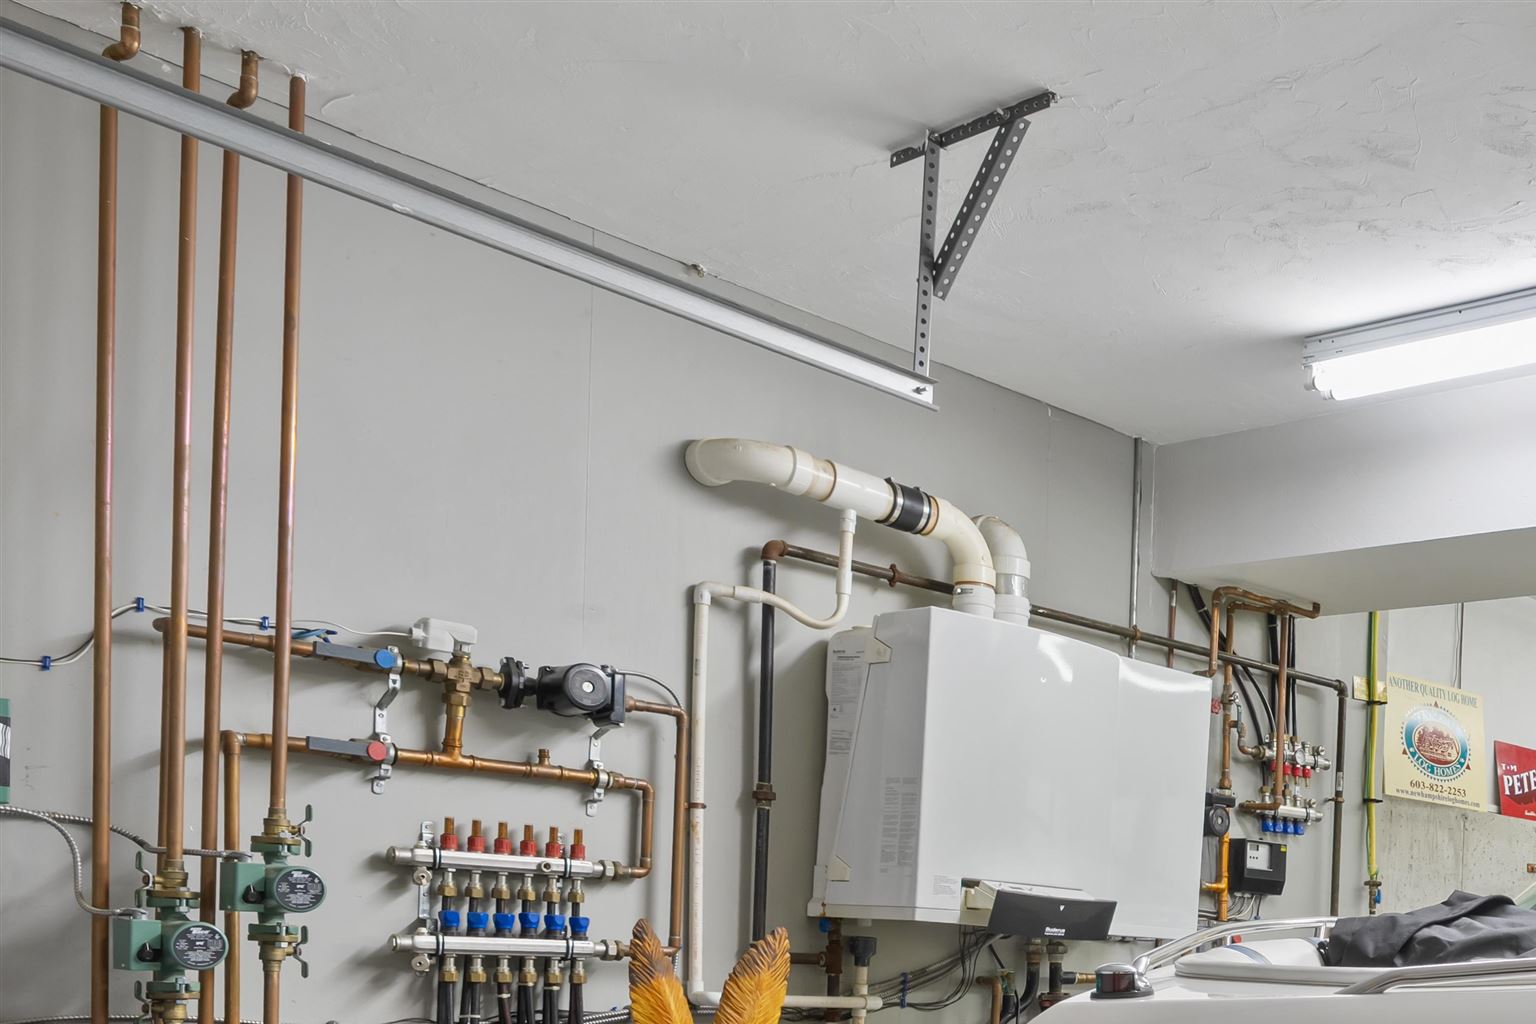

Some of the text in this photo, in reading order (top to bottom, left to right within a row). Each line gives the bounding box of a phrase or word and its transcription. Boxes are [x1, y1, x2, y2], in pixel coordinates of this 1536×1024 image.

[1389, 675, 1478, 706] ANOTHER QUALITY LOG HOME
[1413, 754, 1462, 777] LOG HOMES
[1409, 780, 1467, 798] 603-822-2253
